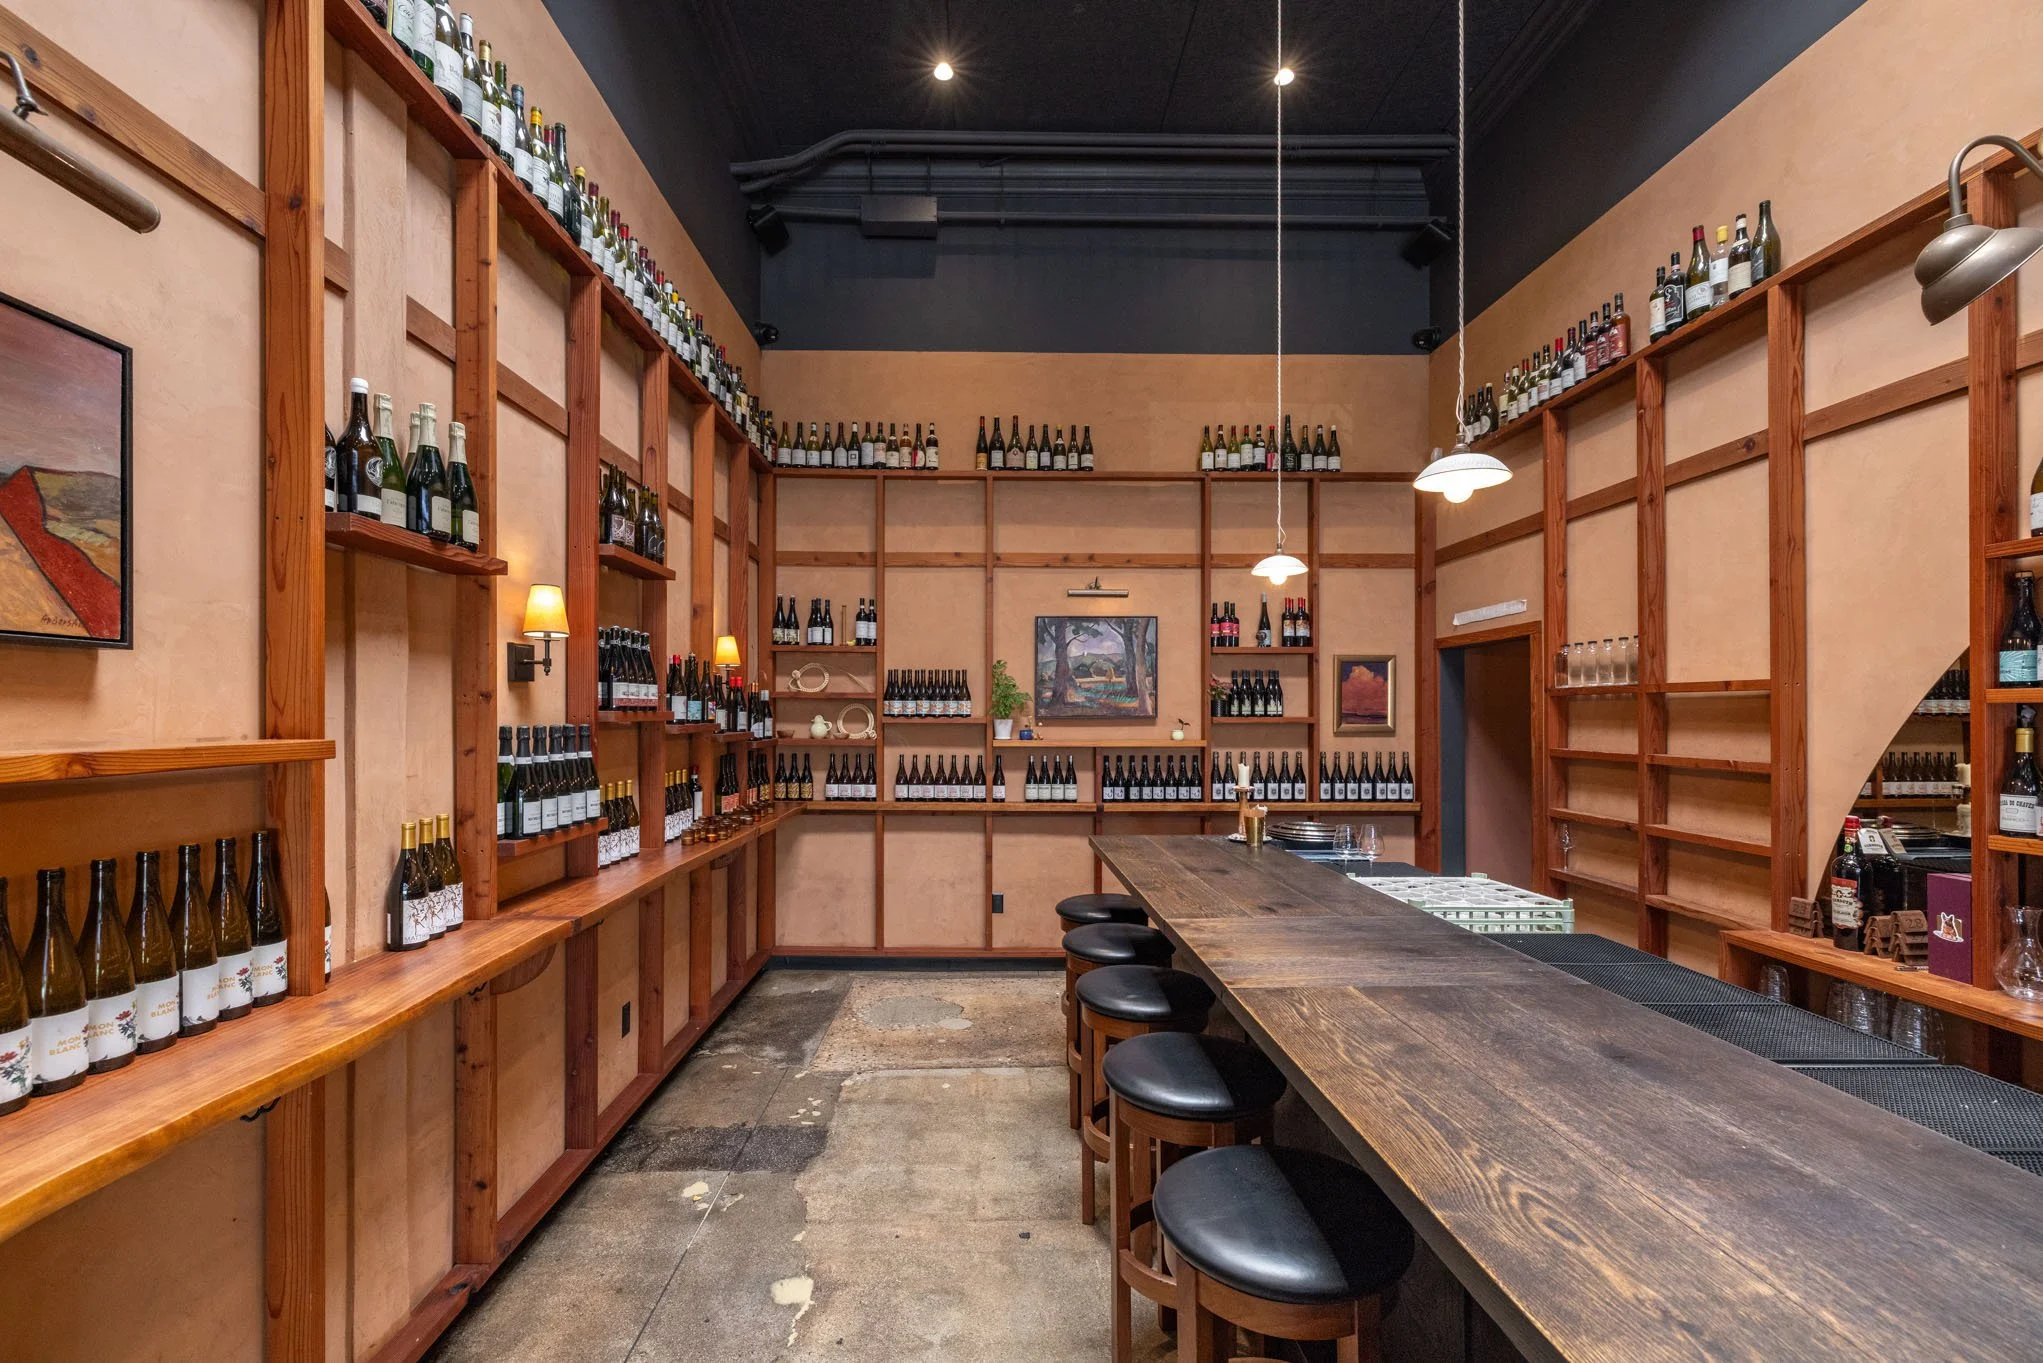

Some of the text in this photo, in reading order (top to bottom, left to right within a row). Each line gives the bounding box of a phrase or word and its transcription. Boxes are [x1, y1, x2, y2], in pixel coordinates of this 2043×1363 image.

[1905, 918, 1924, 929] 28
[158, 1000, 177, 1009] MON
[150, 1005, 177, 1018] BLANC
[88, 1022, 115, 1032] MON
[57, 1034, 82, 1047] MON
[48, 1042, 82, 1056] BLANC
